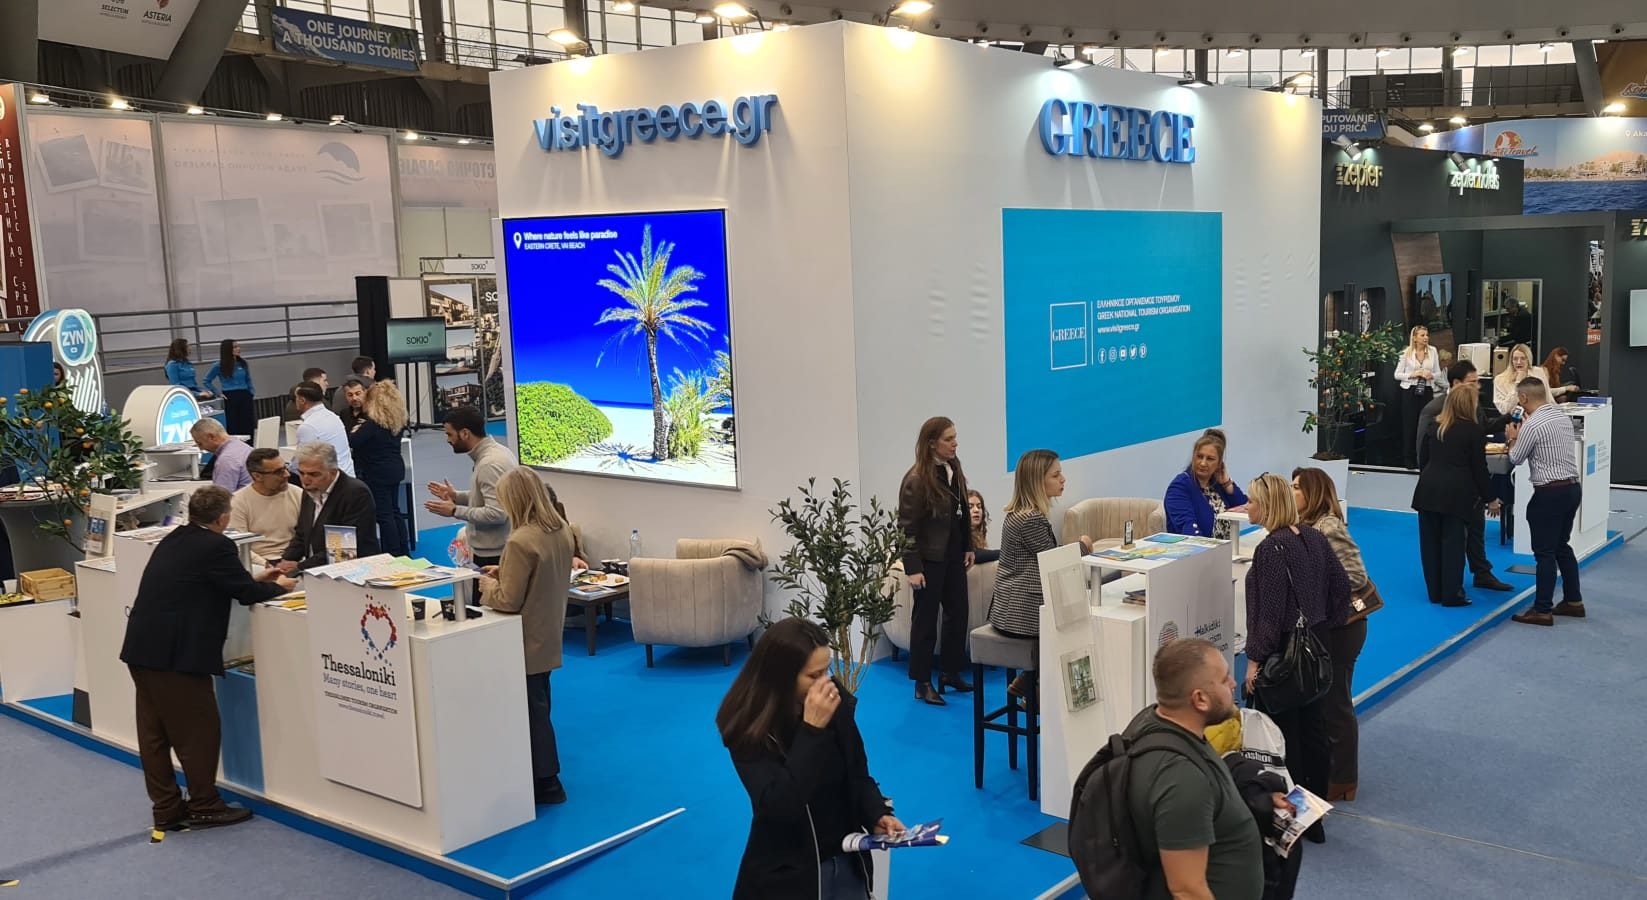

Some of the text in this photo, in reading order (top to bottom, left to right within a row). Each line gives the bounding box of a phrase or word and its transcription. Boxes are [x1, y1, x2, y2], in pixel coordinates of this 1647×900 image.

[143, 10, 172, 22] ASTERIA
[306, 19, 392, 44] ONE JOURNEY
[282, 31, 416, 62] A THOUSAND STORIES
[533, 94, 778, 158] visitgreece.gr
[1039, 98, 1196, 164] GREECE
[1097, 311, 1114, 320] GREEK
[1114, 309, 1137, 319] NATIONAL
[1138, 306, 1159, 317] TOURISM
[61, 330, 84, 347] ZYN
[1052, 327, 1086, 341] GREECE
[321, 653, 396, 686] Thessaloniki
[323, 672, 341, 688] Many
